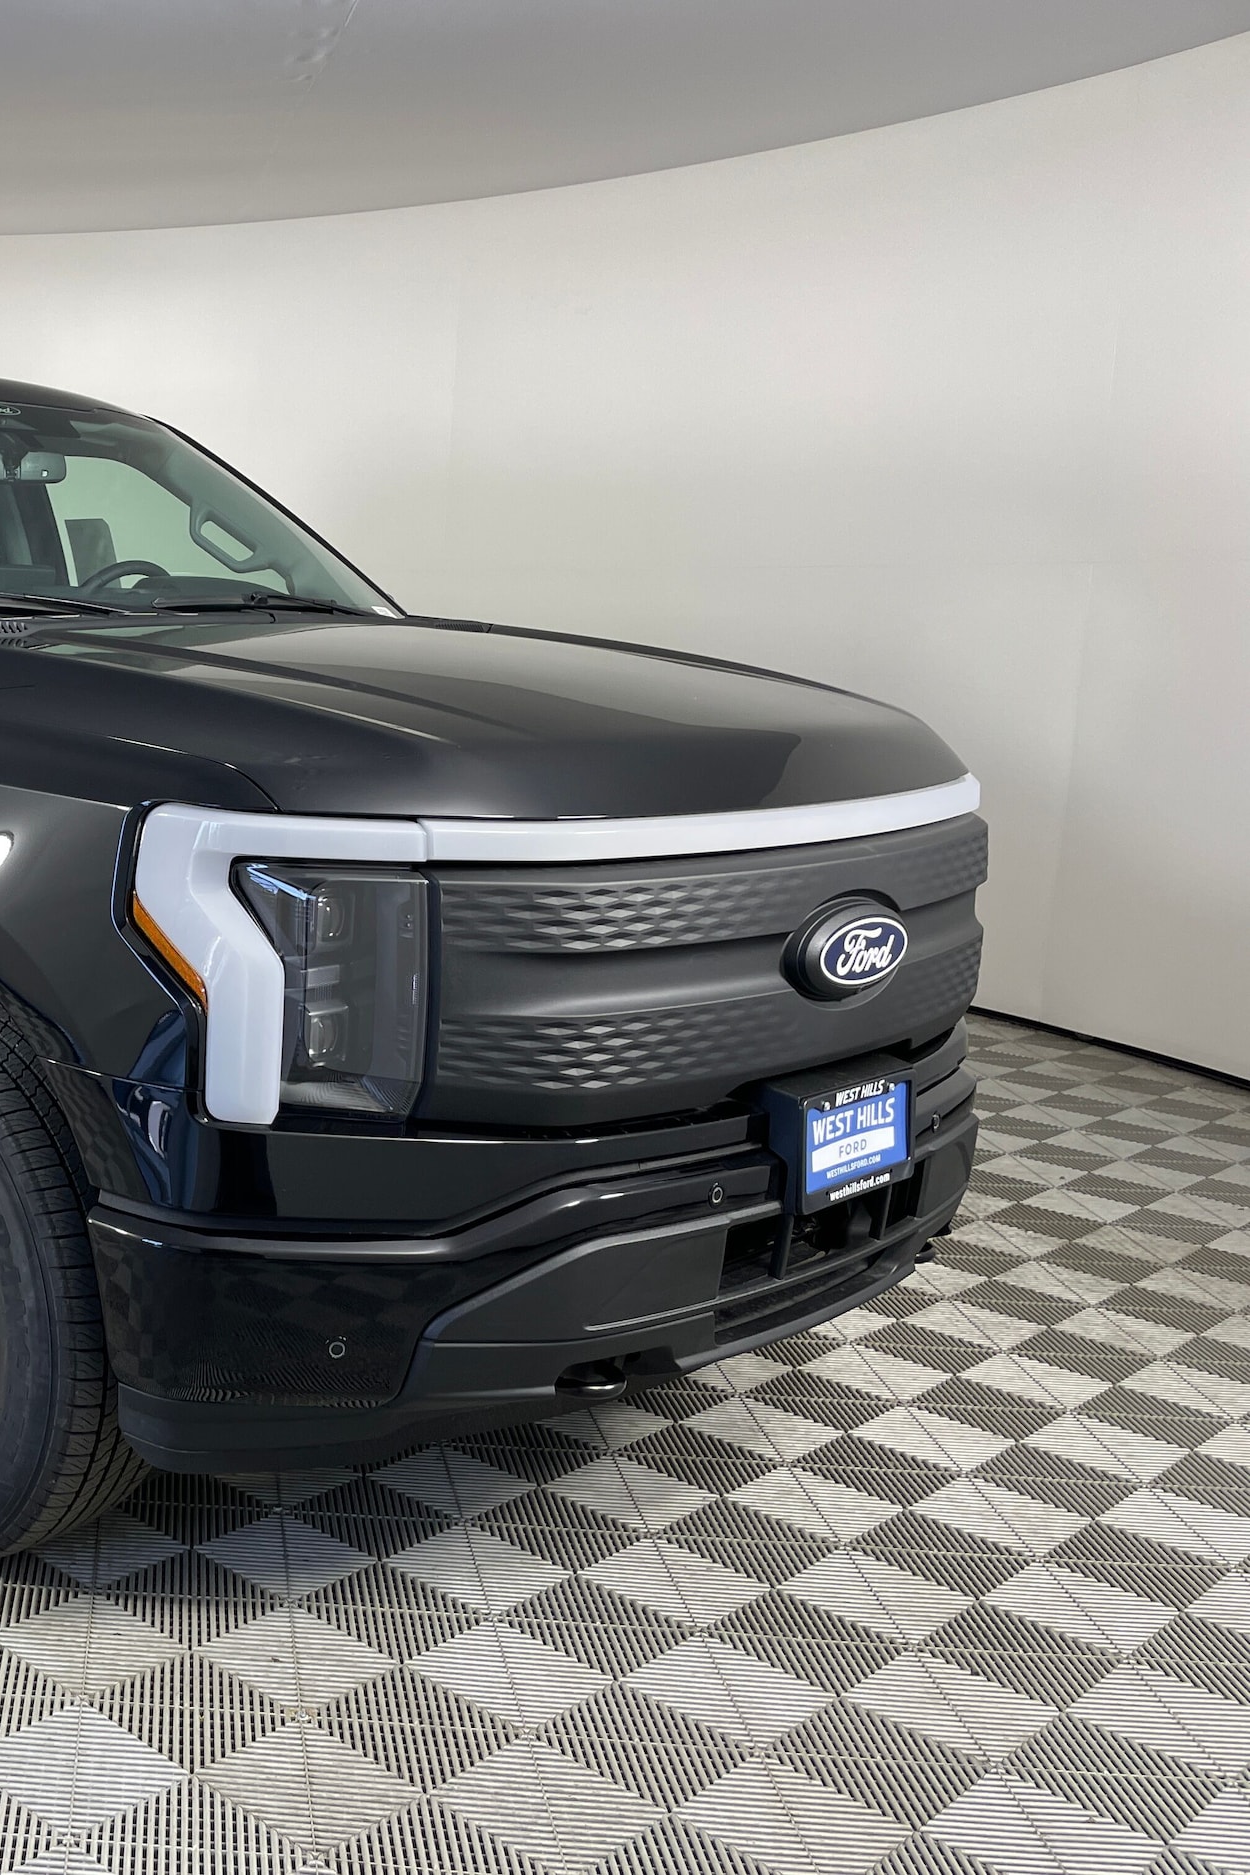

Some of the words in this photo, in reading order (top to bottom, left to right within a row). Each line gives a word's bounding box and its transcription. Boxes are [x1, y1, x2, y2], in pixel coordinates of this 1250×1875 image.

[836, 927, 895, 976] Ford
[835, 1086, 861, 1107] WEST
[860, 1079, 886, 1098] HILLS
[812, 1109, 854, 1146] WEST
[856, 1097, 896, 1130] HILLS
[838, 1138, 867, 1159] FORD
[826, 1154, 882, 1179] WESTHILLSFORD.COM
[829, 1172, 891, 1201] westhillsford.com
